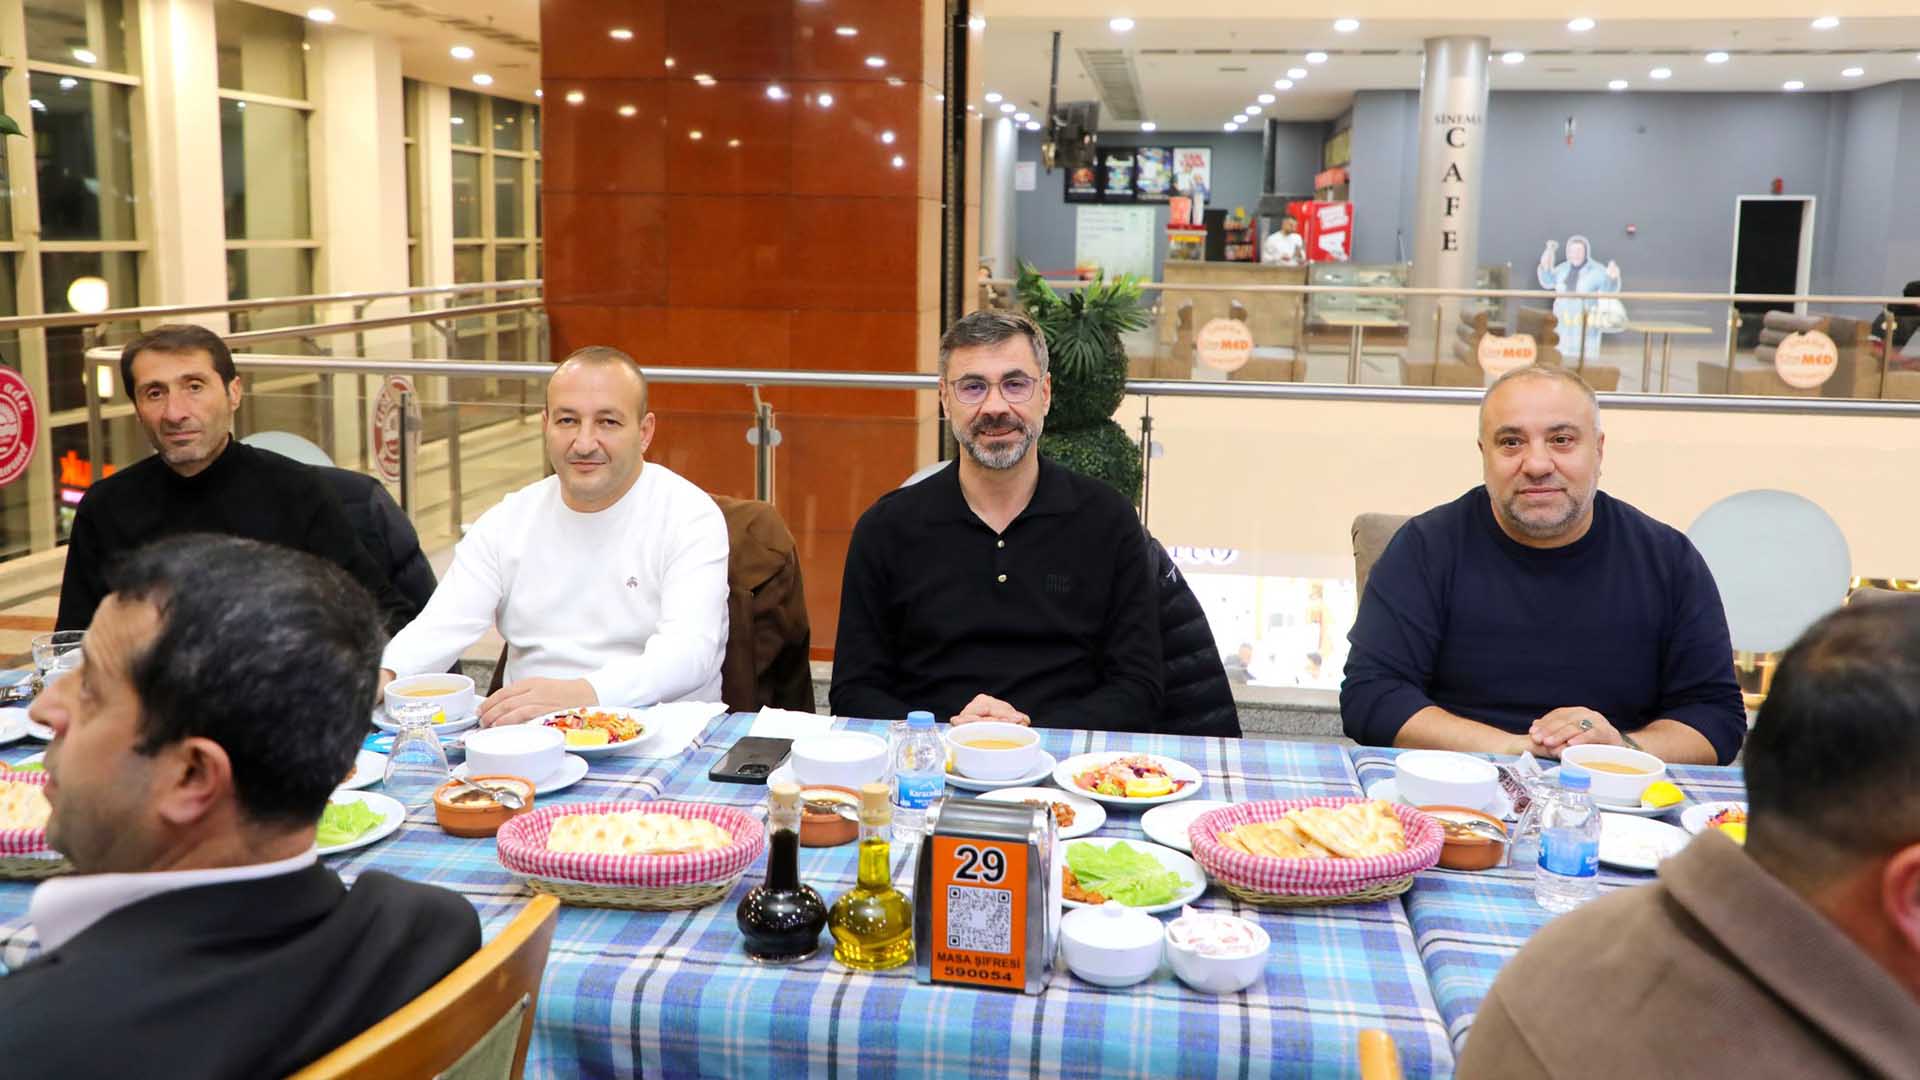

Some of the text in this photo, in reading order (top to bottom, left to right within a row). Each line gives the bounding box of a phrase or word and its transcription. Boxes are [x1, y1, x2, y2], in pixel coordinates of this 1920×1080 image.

[1441, 127, 1466, 252] CAFE
[954, 845, 1006, 884] 29
[937, 951, 972, 964] MASA
[944, 965, 1013, 982] 590054
